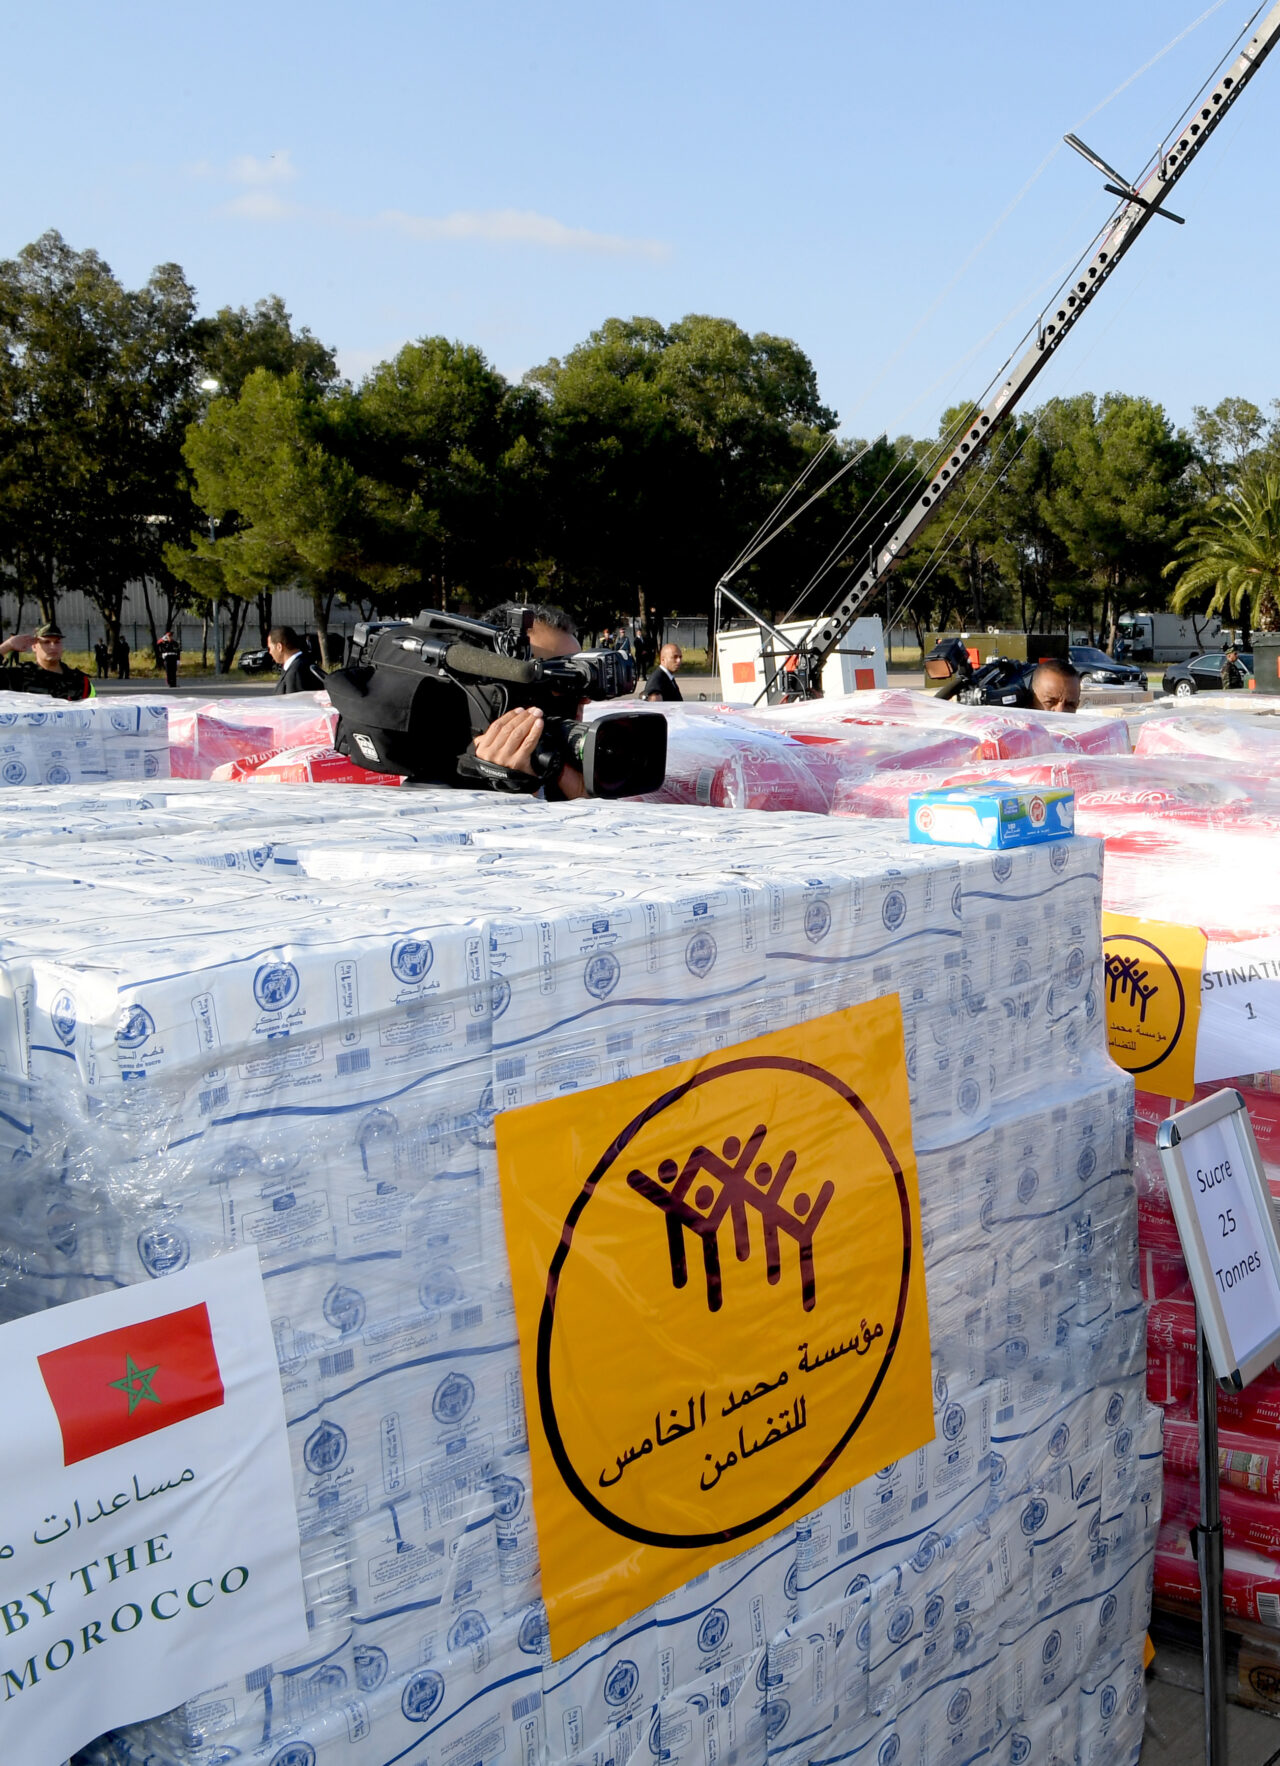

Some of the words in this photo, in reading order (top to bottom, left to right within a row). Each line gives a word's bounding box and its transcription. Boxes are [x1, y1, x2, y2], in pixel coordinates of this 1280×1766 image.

[1244, 1002, 1258, 1019] 1
[1196, 1160, 1233, 1193] Sucre
[1218, 1209, 1237, 1237] 25
[1215, 1250, 1262, 1293] Tonnes
[798, 1318, 884, 1373] مؤسسة
[721, 1371, 788, 1418] محمد
[599, 1391, 707, 1487] الخامس
[700, 1395, 807, 1491] للتضامن
[34, 1468, 195, 1544] مساعدات
[0, 1581, 57, 1635] BY
[70, 1533, 173, 1596] THE
[0, 1566, 249, 1701] MOROCCO
